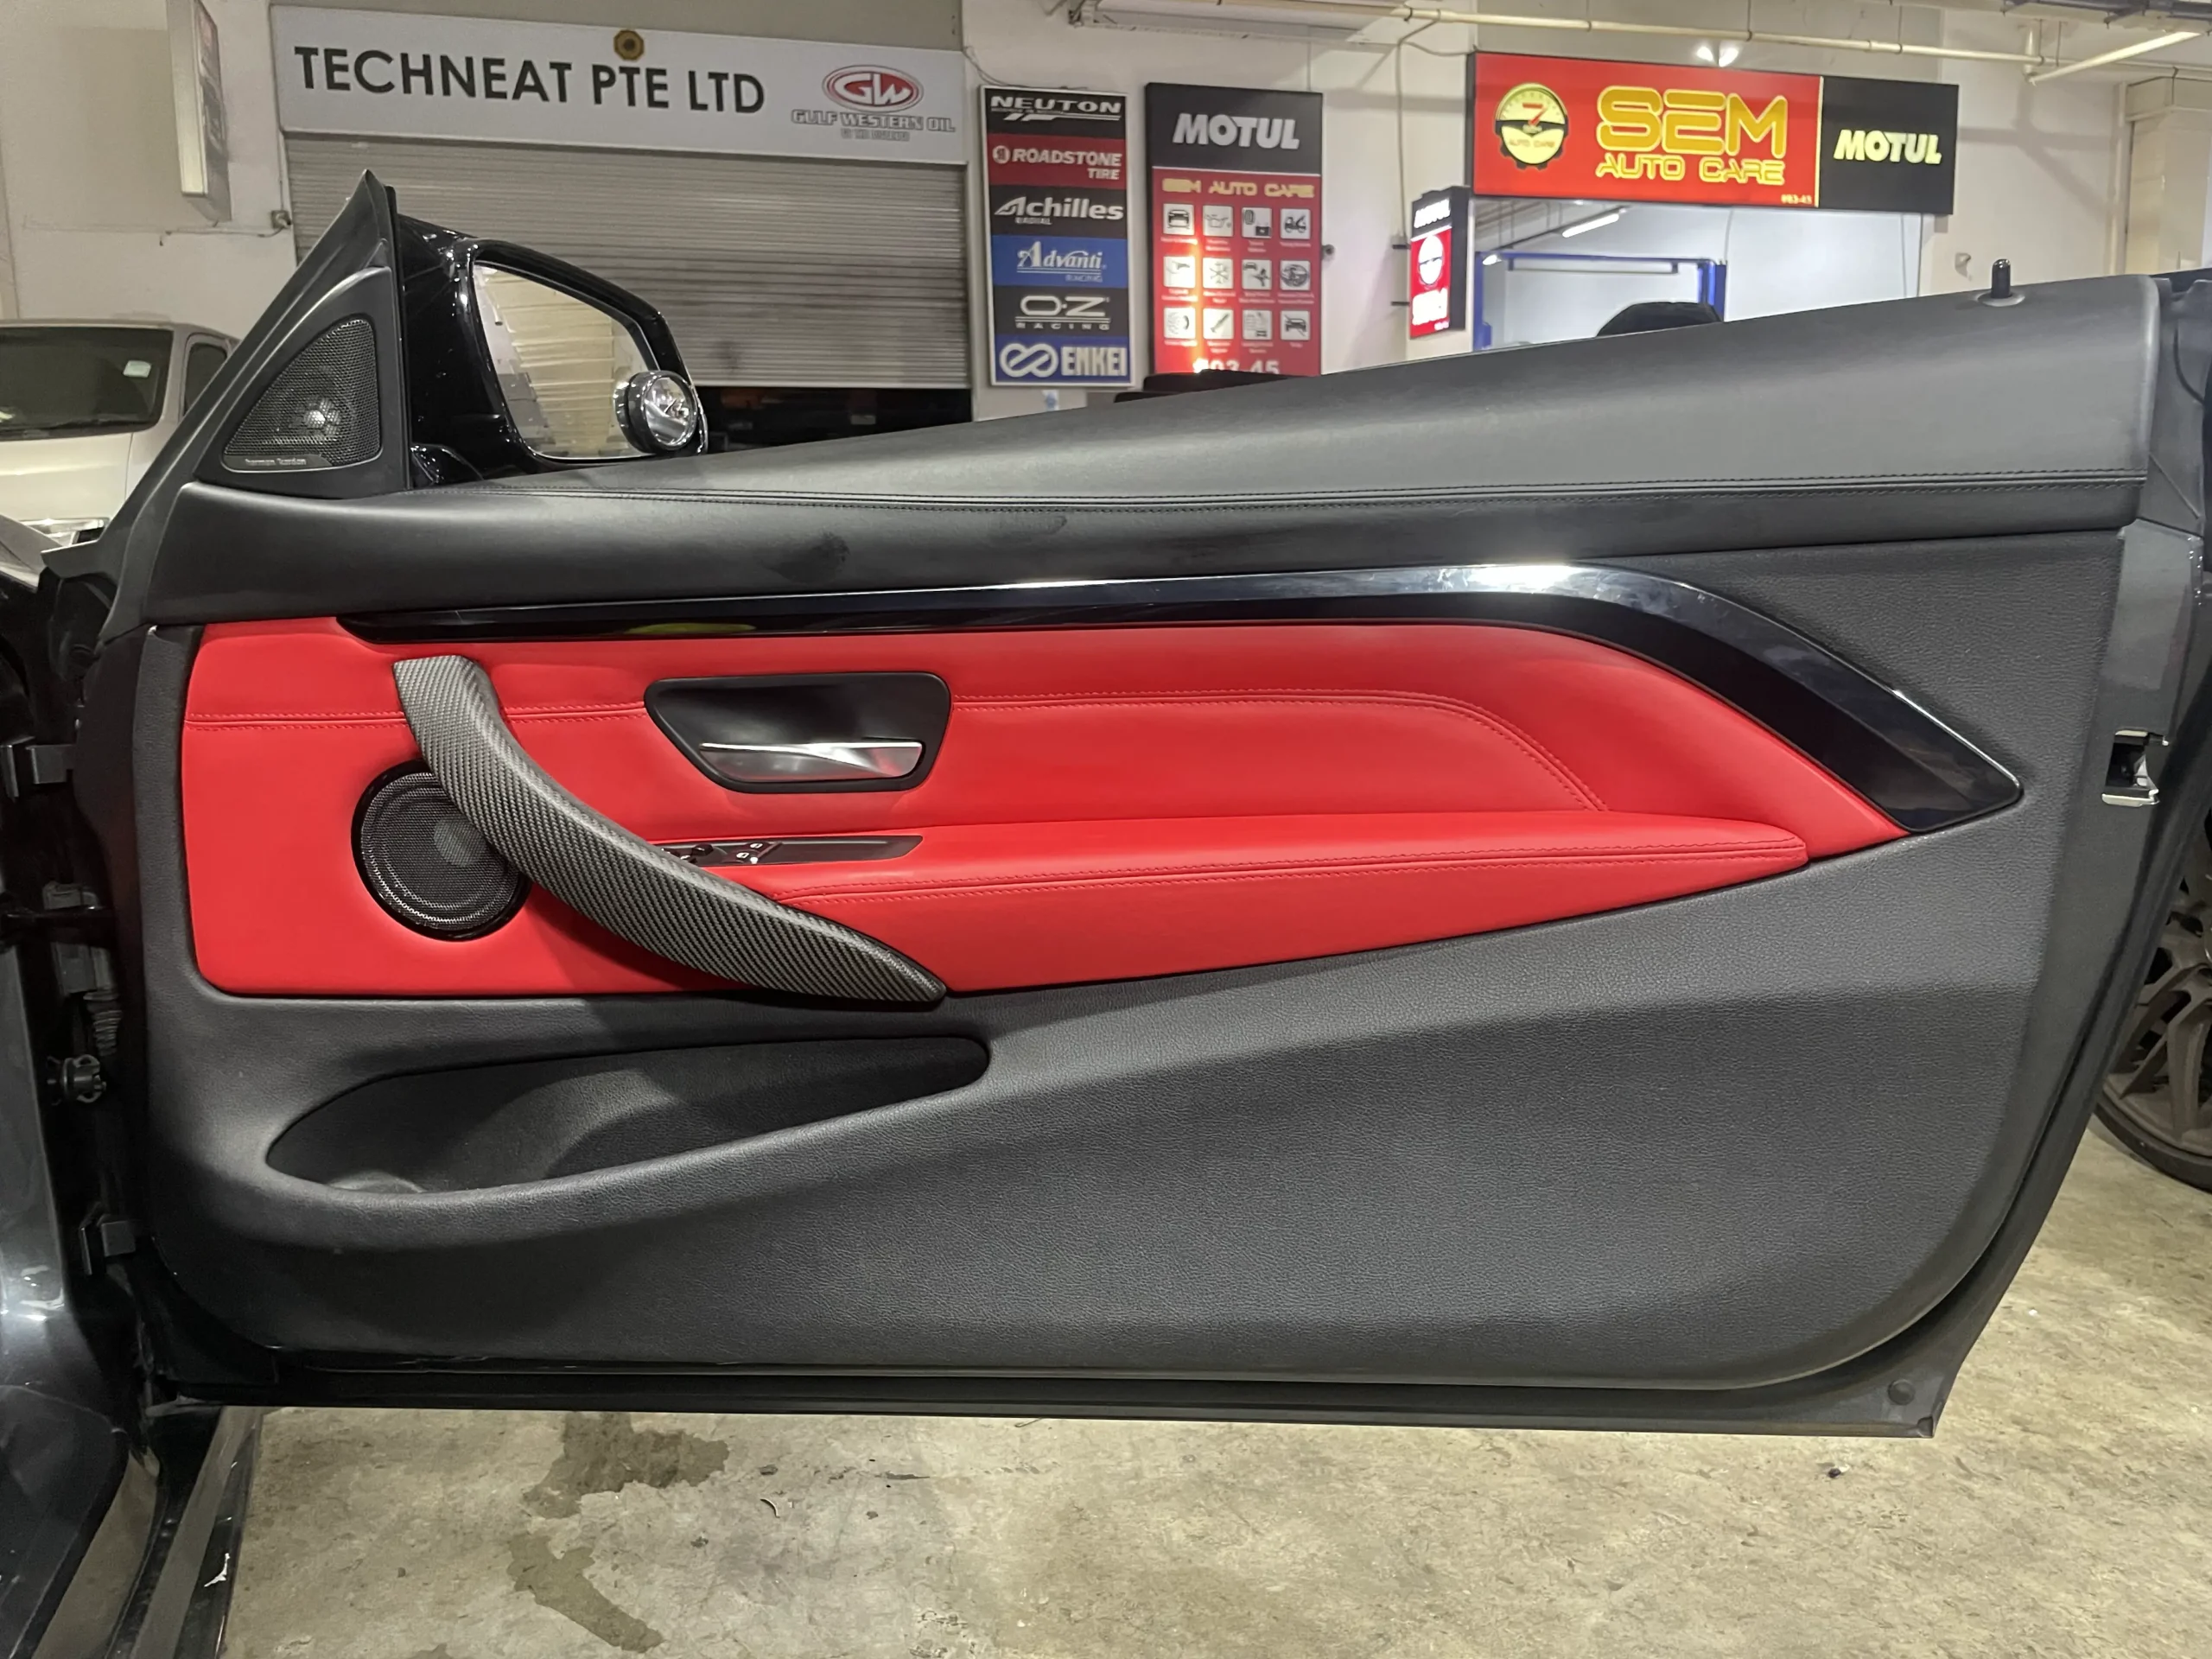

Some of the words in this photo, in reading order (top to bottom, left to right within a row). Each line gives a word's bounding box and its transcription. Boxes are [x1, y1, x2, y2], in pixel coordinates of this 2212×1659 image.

[294, 46, 572, 103] TECHNEAT
[592, 64, 669, 109] PTE
[688, 70, 766, 114] LTD
[990, 95, 1122, 113] NEUTON
[791, 109, 838, 126] GULF
[925, 117, 956, 132] OIL
[1172, 112, 1300, 149] MOTUL
[1596, 85, 1788, 159] SEM
[1012, 148, 1122, 167] ROADSTONE
[1833, 129, 1942, 164] MOTUL
[1087, 167, 1121, 180] TIRE
[1596, 152, 1686, 181] AUTO
[1699, 156, 1786, 186] CARE
[994, 196, 1124, 220] Achilles
[1016, 240, 1103, 270] Advanti
[1015, 322, 1110, 331] RACING
[1061, 346, 1128, 377] ENKEI
